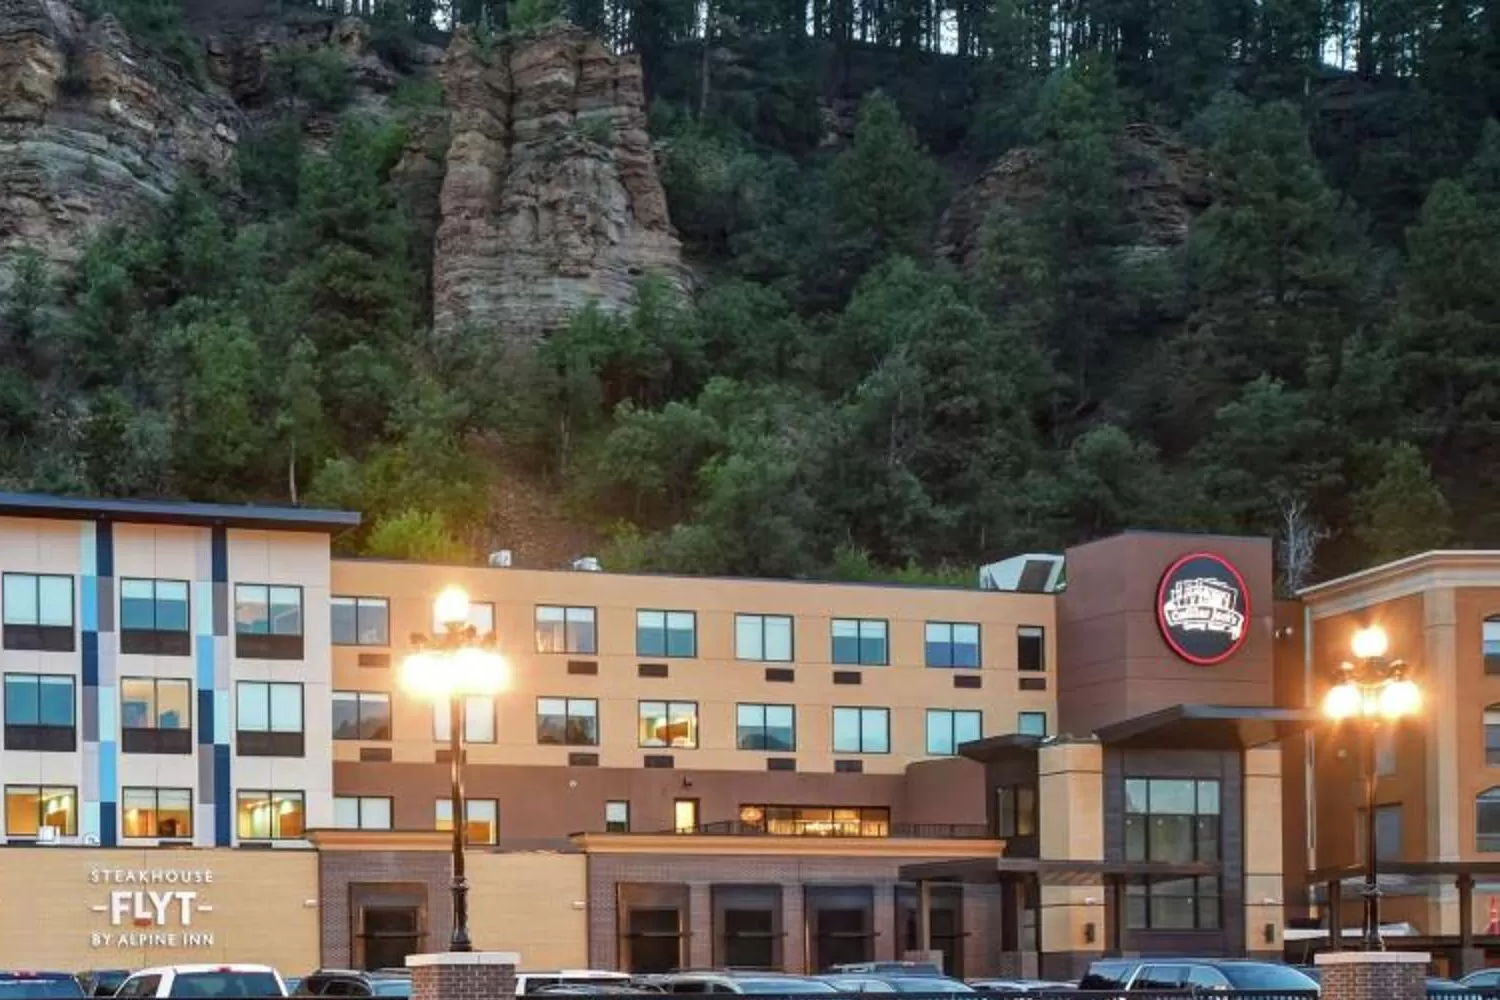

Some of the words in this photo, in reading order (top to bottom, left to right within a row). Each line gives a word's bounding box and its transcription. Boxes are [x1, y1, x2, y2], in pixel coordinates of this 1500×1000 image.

[91, 868, 213, 883] STEAKHOUSE
[111, 890, 197, 925] FLYT
[92, 933, 113, 945] BY
[117, 933, 177, 946] ALPINE
[183, 933, 214, 946] INN
